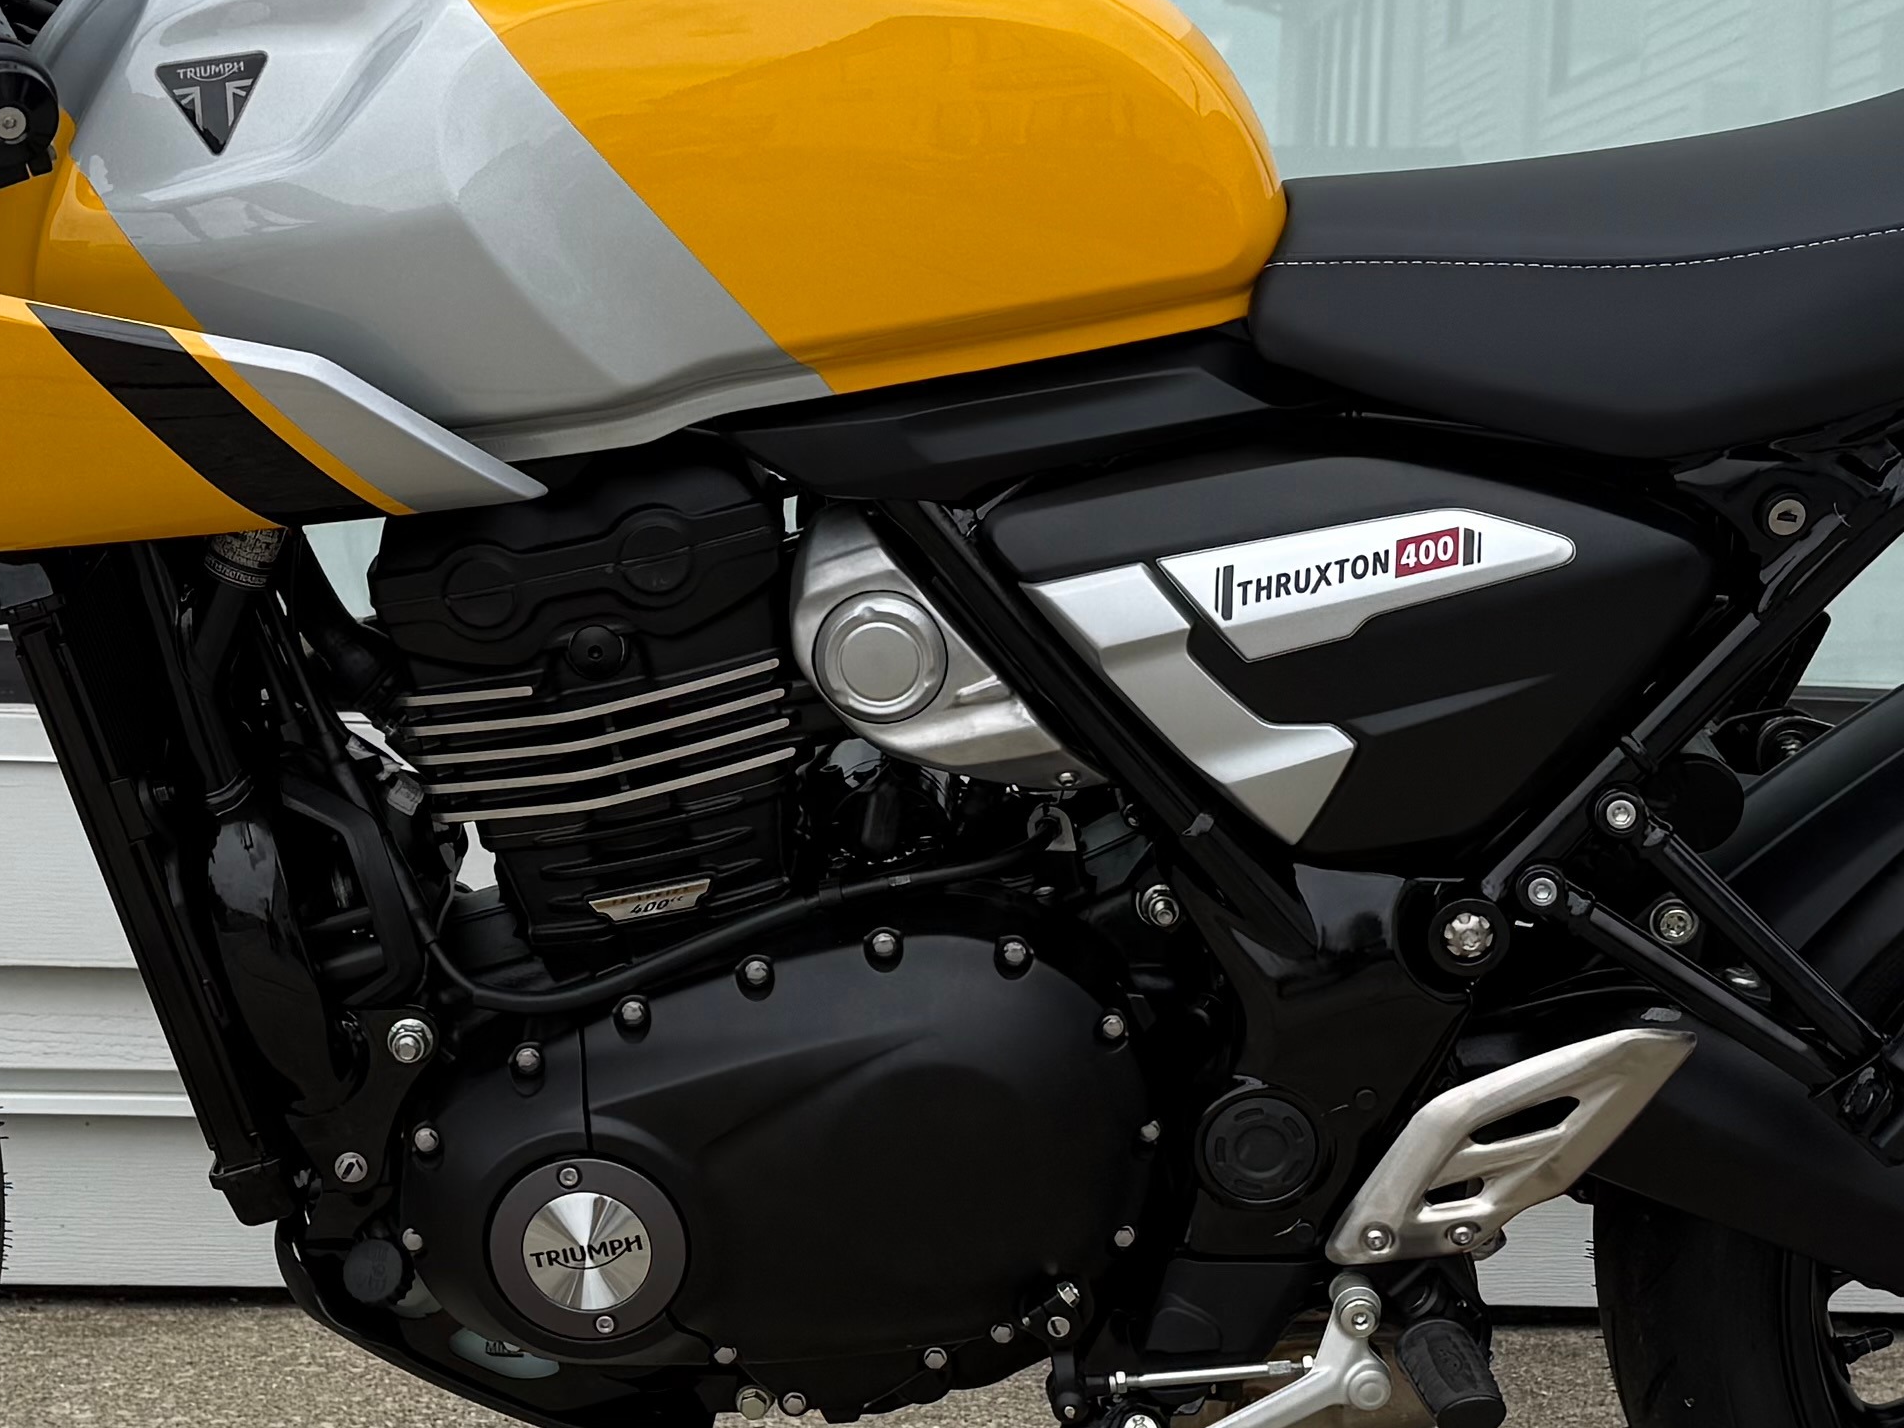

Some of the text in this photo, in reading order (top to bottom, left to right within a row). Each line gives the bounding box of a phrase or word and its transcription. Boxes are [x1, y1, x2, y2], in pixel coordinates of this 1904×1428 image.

[176, 61, 245, 81] TRIUMPH
[1237, 535, 1455, 606] THRUXTON 400
[529, 1234, 643, 1270] TRIUMPH
